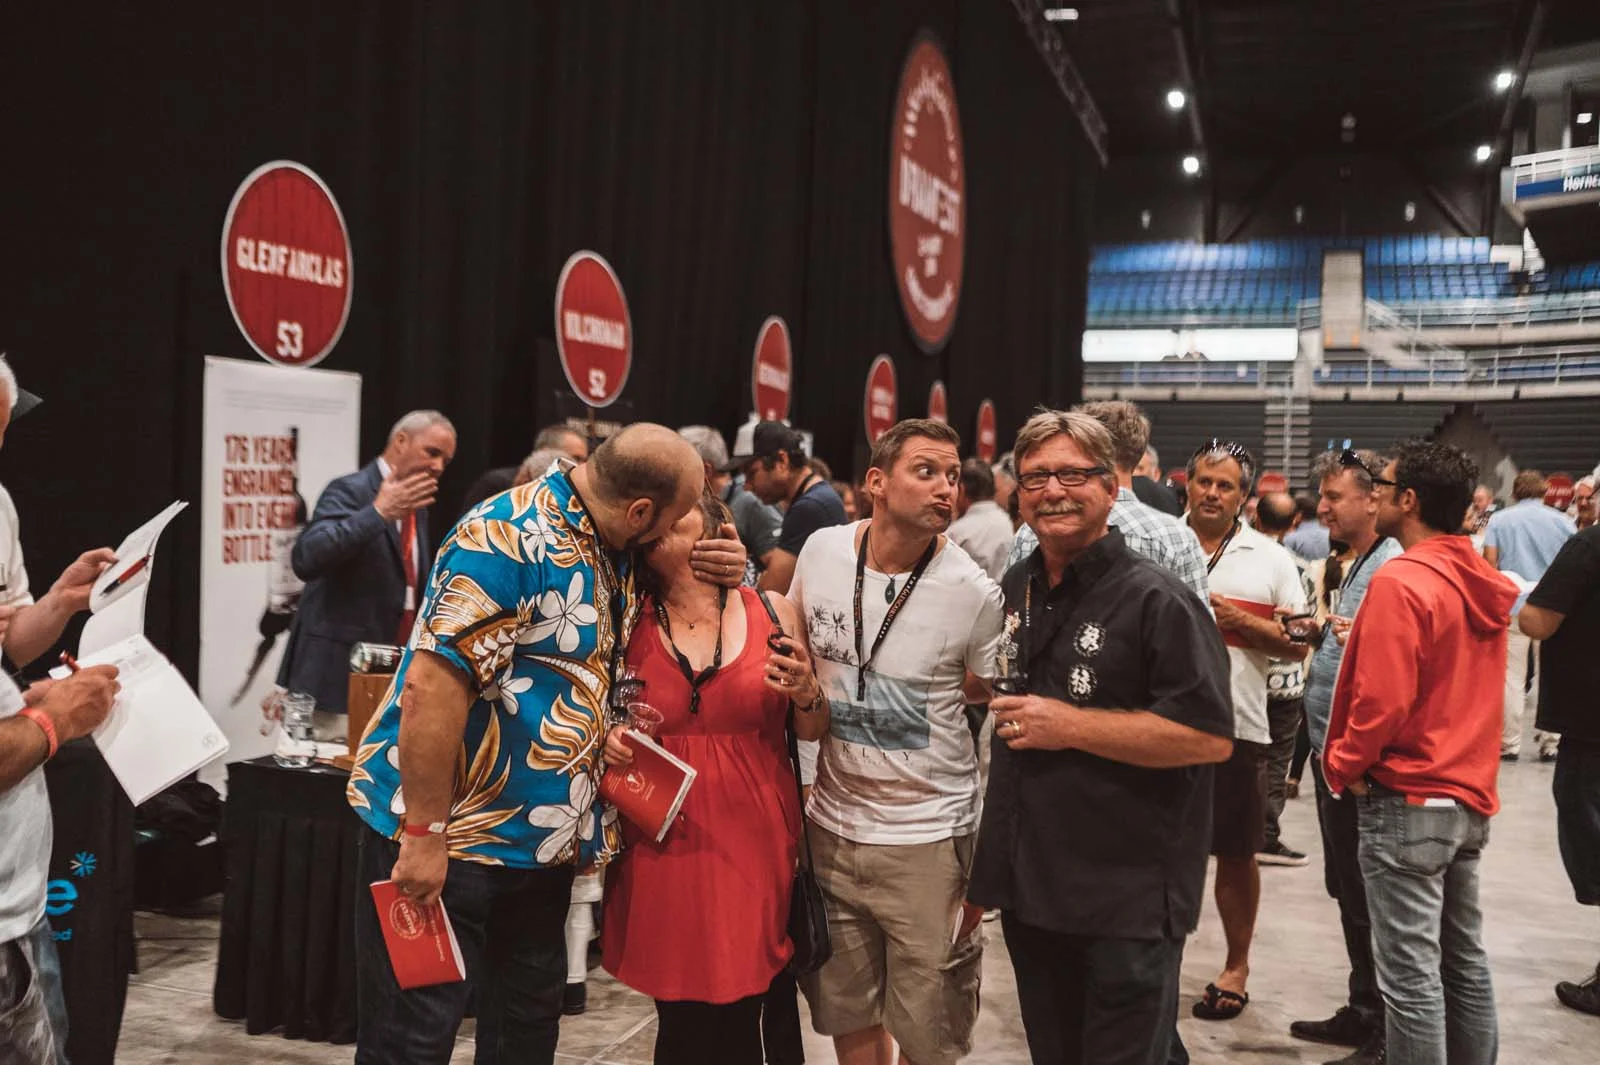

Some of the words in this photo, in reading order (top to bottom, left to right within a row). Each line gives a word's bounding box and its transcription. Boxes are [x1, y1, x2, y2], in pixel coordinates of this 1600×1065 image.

[236, 237, 344, 288] GLENFARCLAS
[276, 319, 305, 358] 53
[223, 502, 253, 530] INTO
